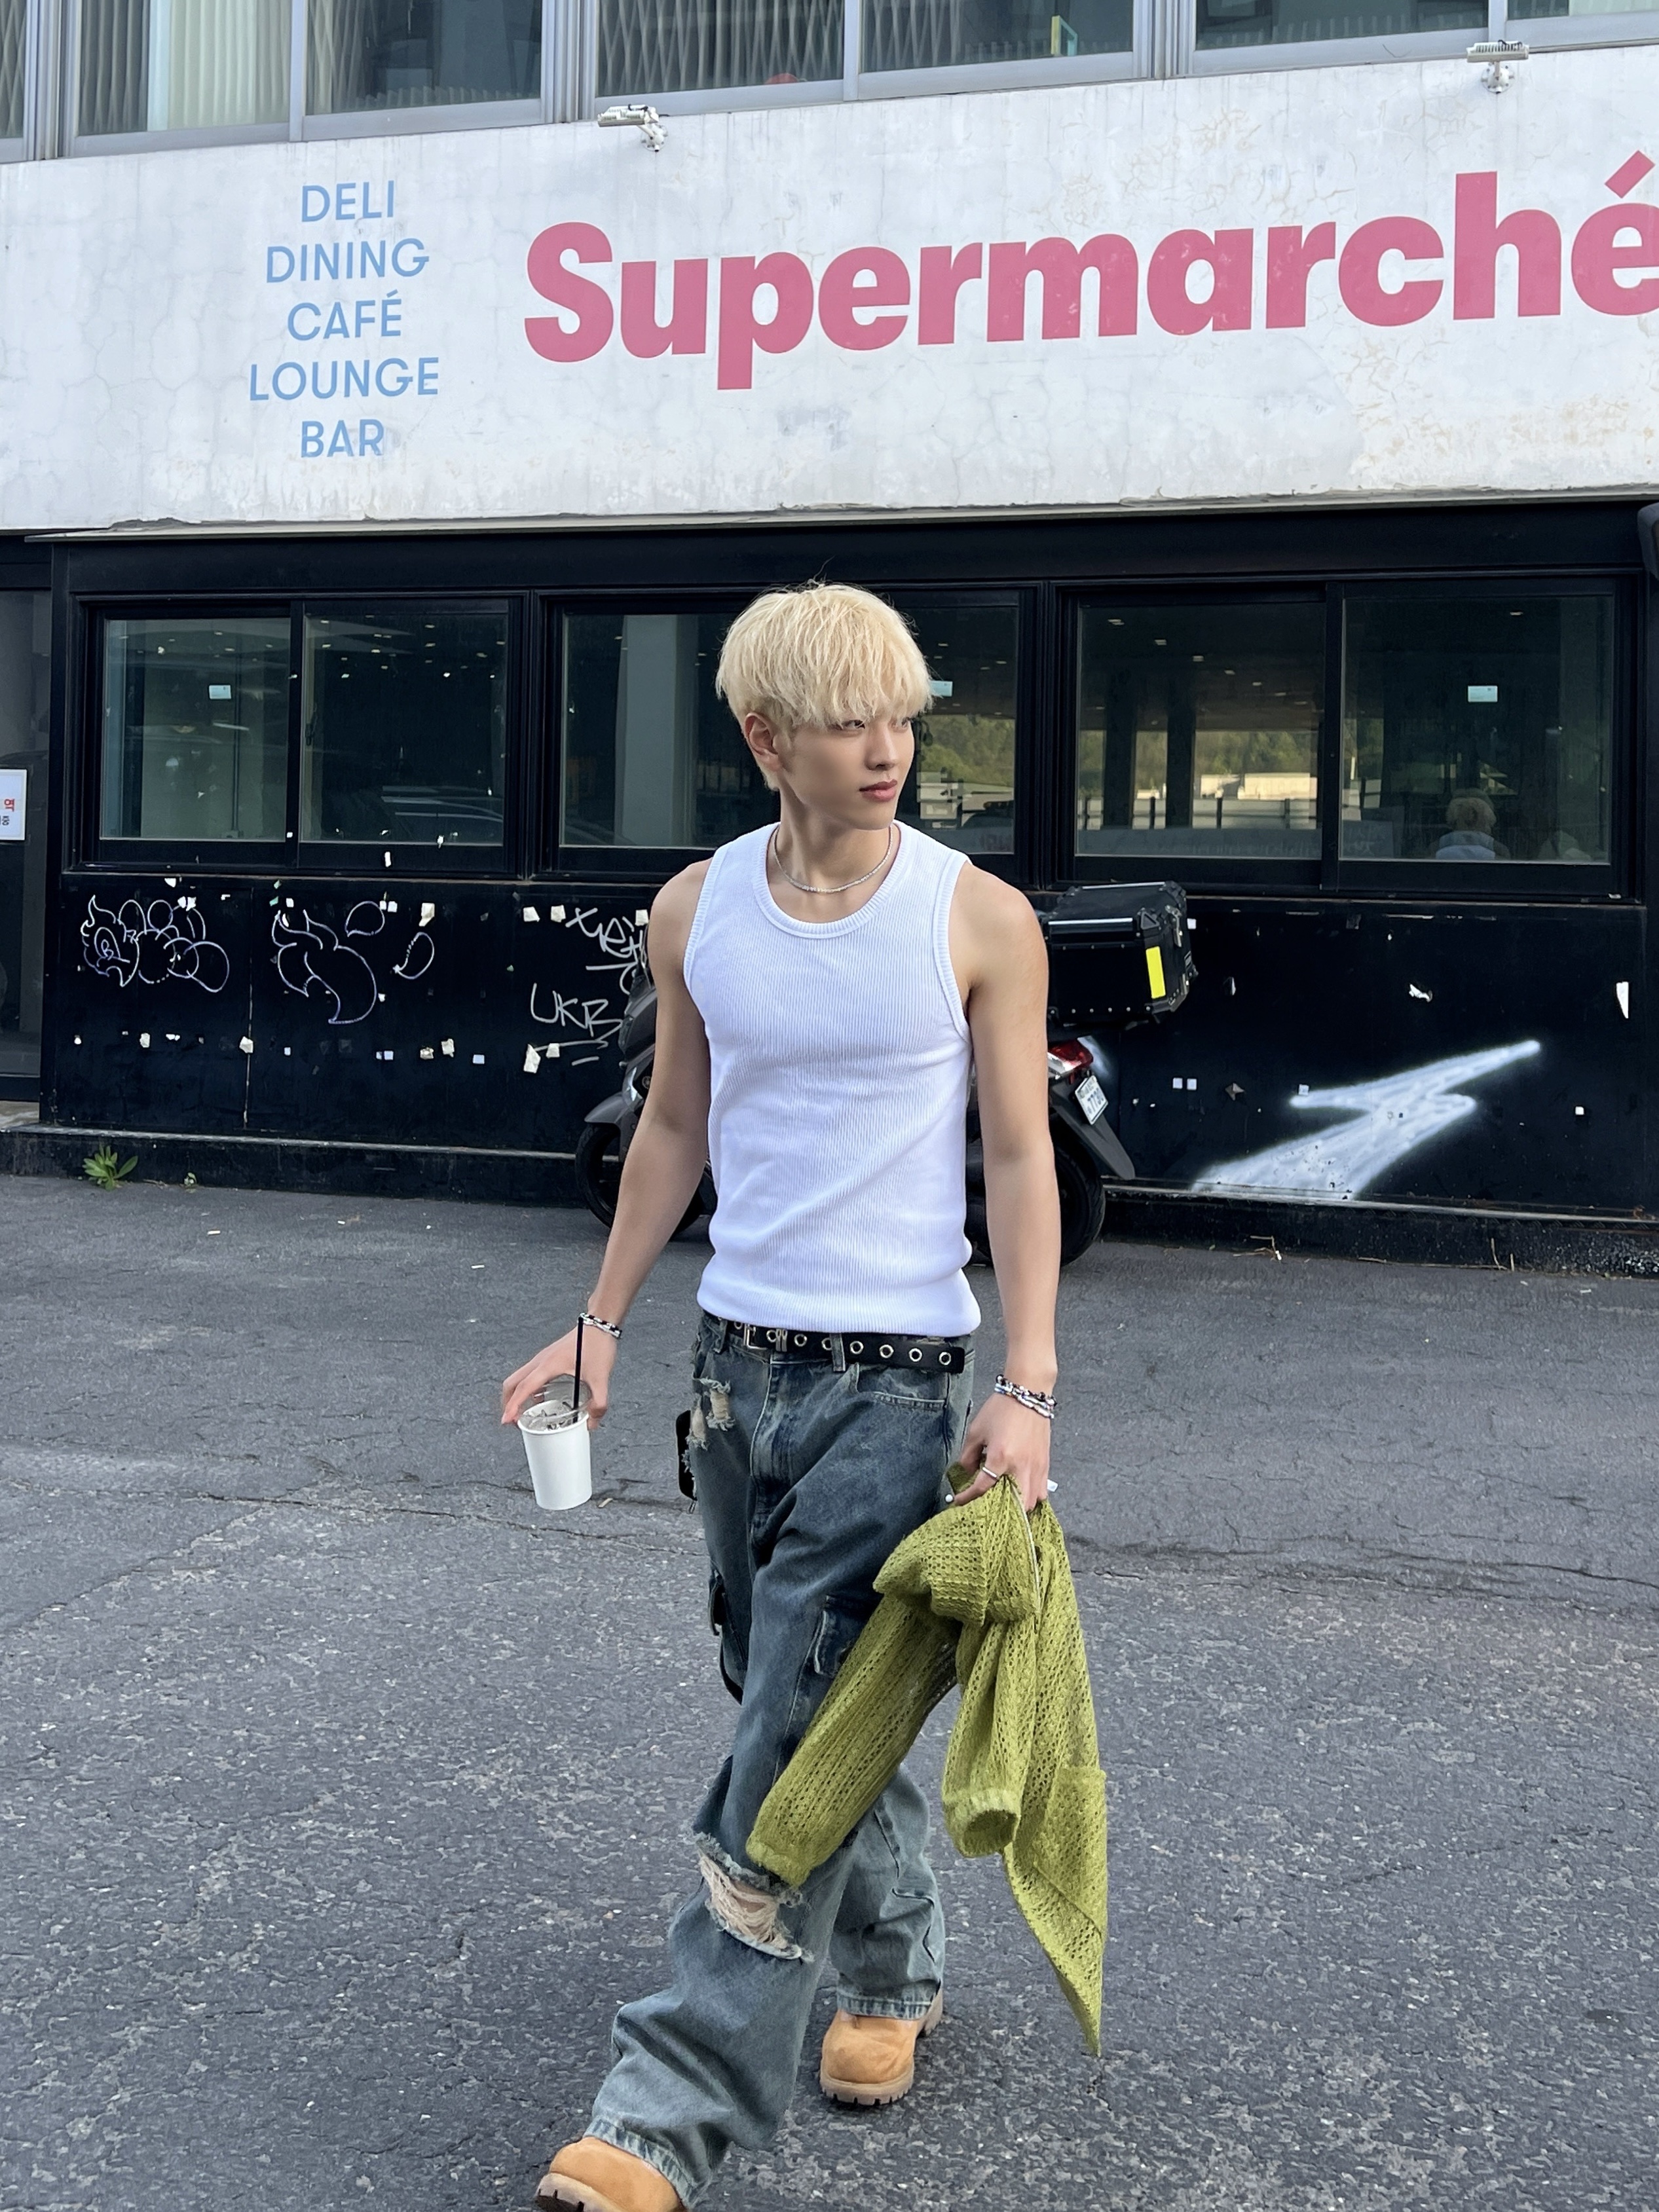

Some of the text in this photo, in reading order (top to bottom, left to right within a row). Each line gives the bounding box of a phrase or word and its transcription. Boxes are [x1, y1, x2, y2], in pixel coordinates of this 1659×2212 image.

[301, 180, 395, 223] DELI
[266, 237, 430, 284] DINING
[524, 150, 1659, 390] Supermarché
[287, 289, 402, 342] CAFÉ
[249, 356, 439, 401] LOUNGE
[301, 418, 385, 458] BAR
